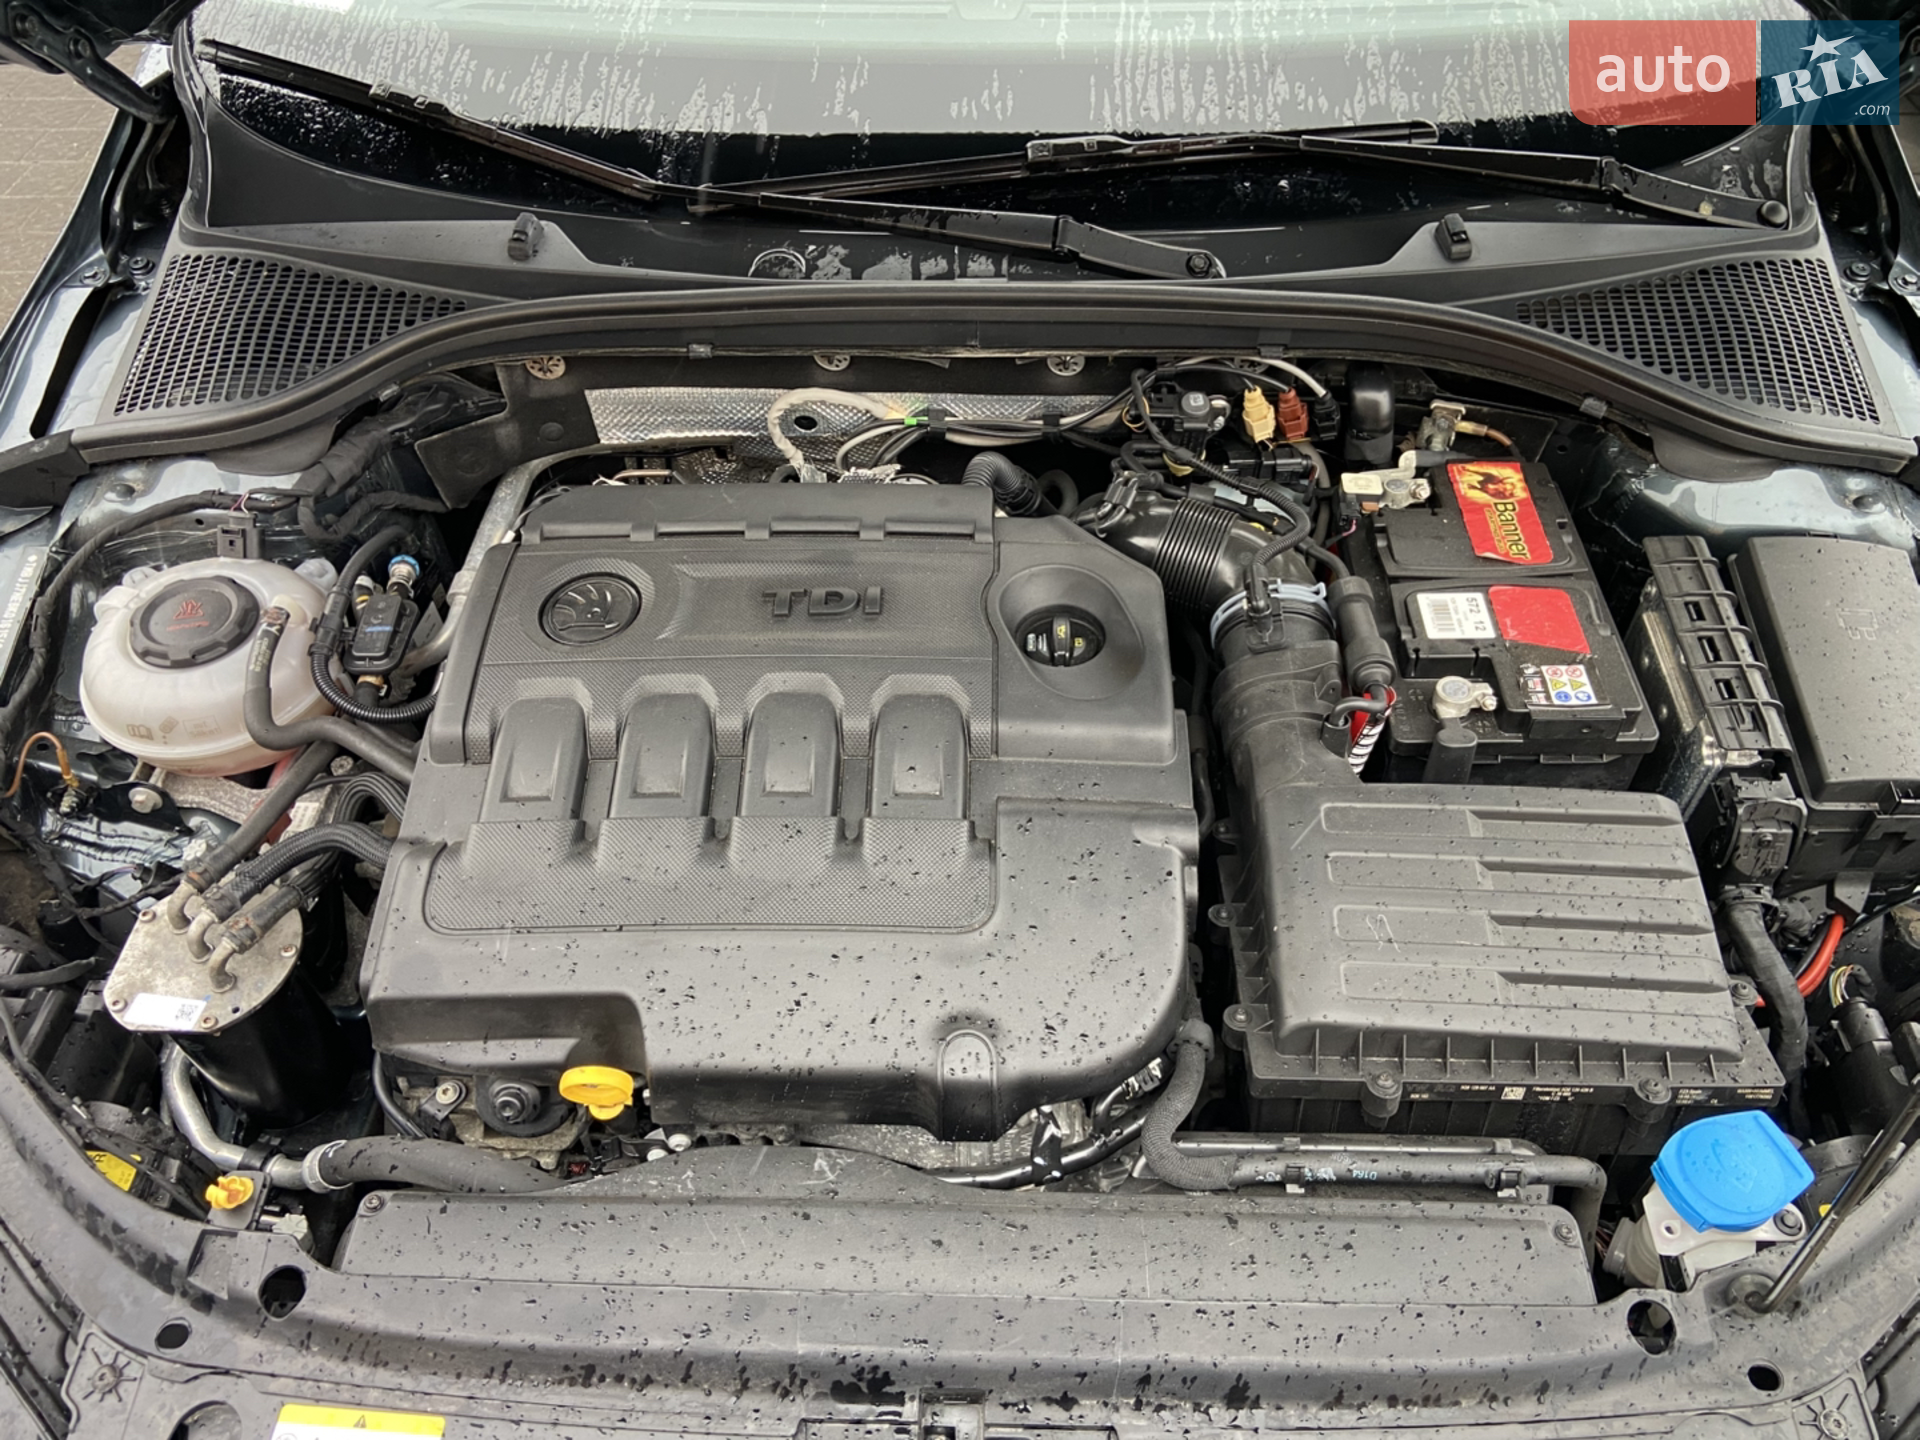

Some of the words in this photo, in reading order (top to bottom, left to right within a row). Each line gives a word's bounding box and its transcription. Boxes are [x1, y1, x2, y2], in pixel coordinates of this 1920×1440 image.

[1493, 501, 1530, 560] Banner
[762, 586, 883, 618] TDI
[1466, 596, 1481, 615] 572
[1473, 619, 1487, 632] 12
